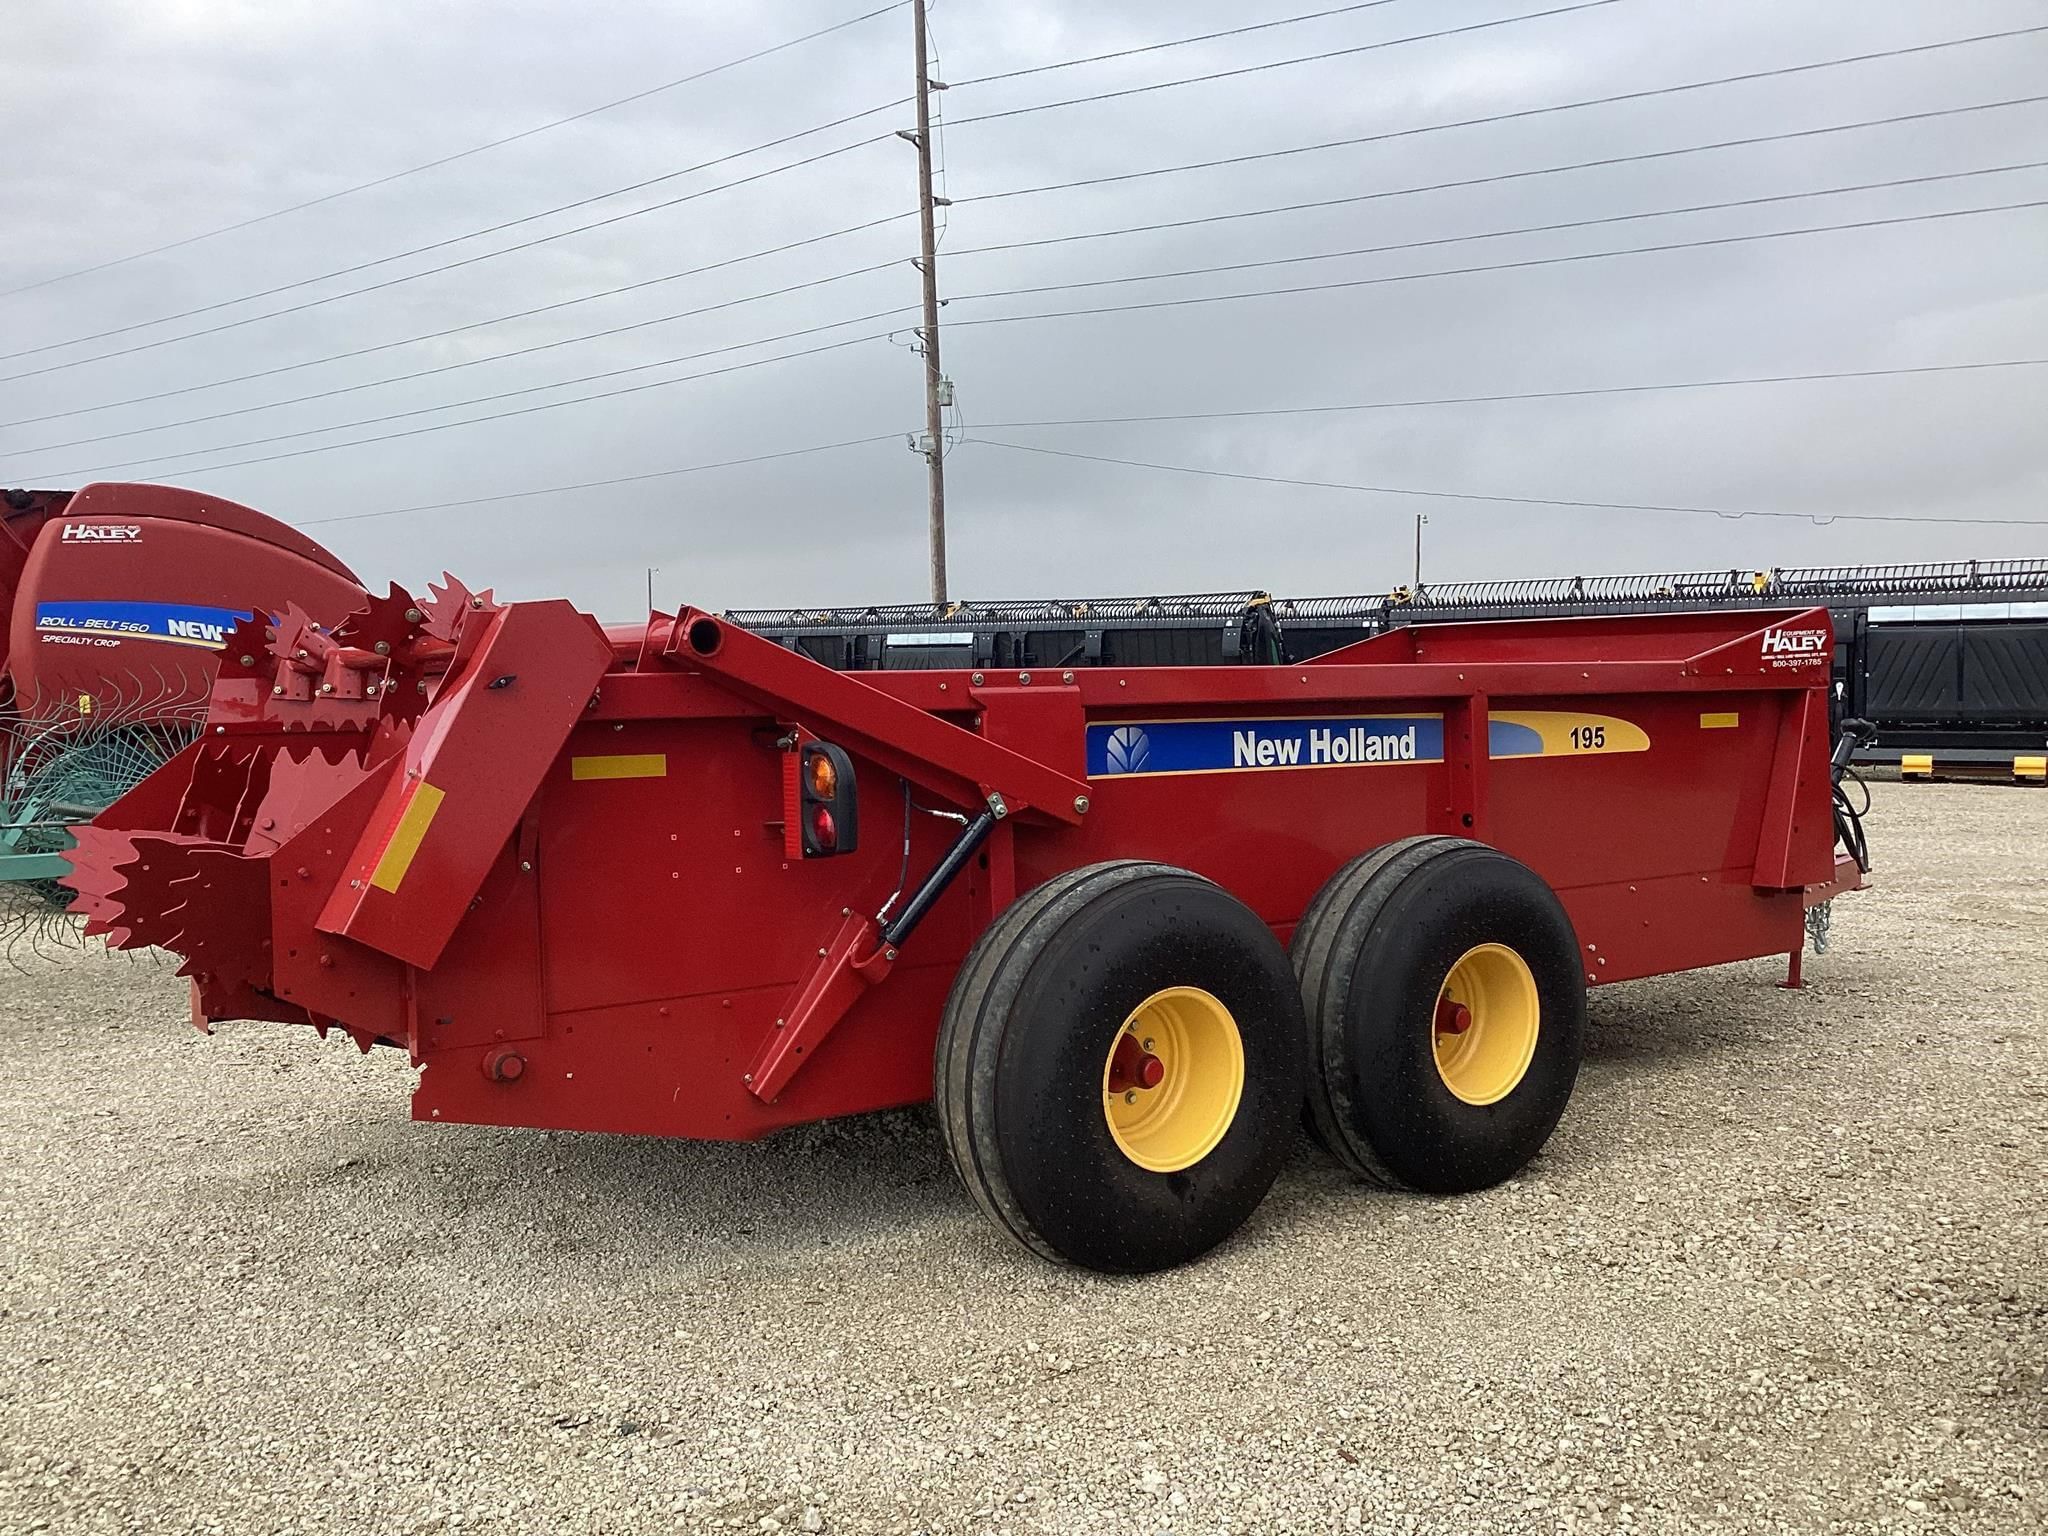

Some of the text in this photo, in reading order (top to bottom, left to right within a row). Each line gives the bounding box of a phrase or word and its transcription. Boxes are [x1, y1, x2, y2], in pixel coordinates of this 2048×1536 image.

[62, 524, 141, 539] HALEY
[118, 622, 150, 633] 560
[168, 619, 223, 642] NEW
[41, 634, 121, 648] SPECIALTY CROP
[1761, 629, 1827, 653] HALEY
[1772, 658, 1822, 668] 800-397-1785
[1233, 726, 1416, 767] New Holland
[1570, 726, 1605, 749] 195
